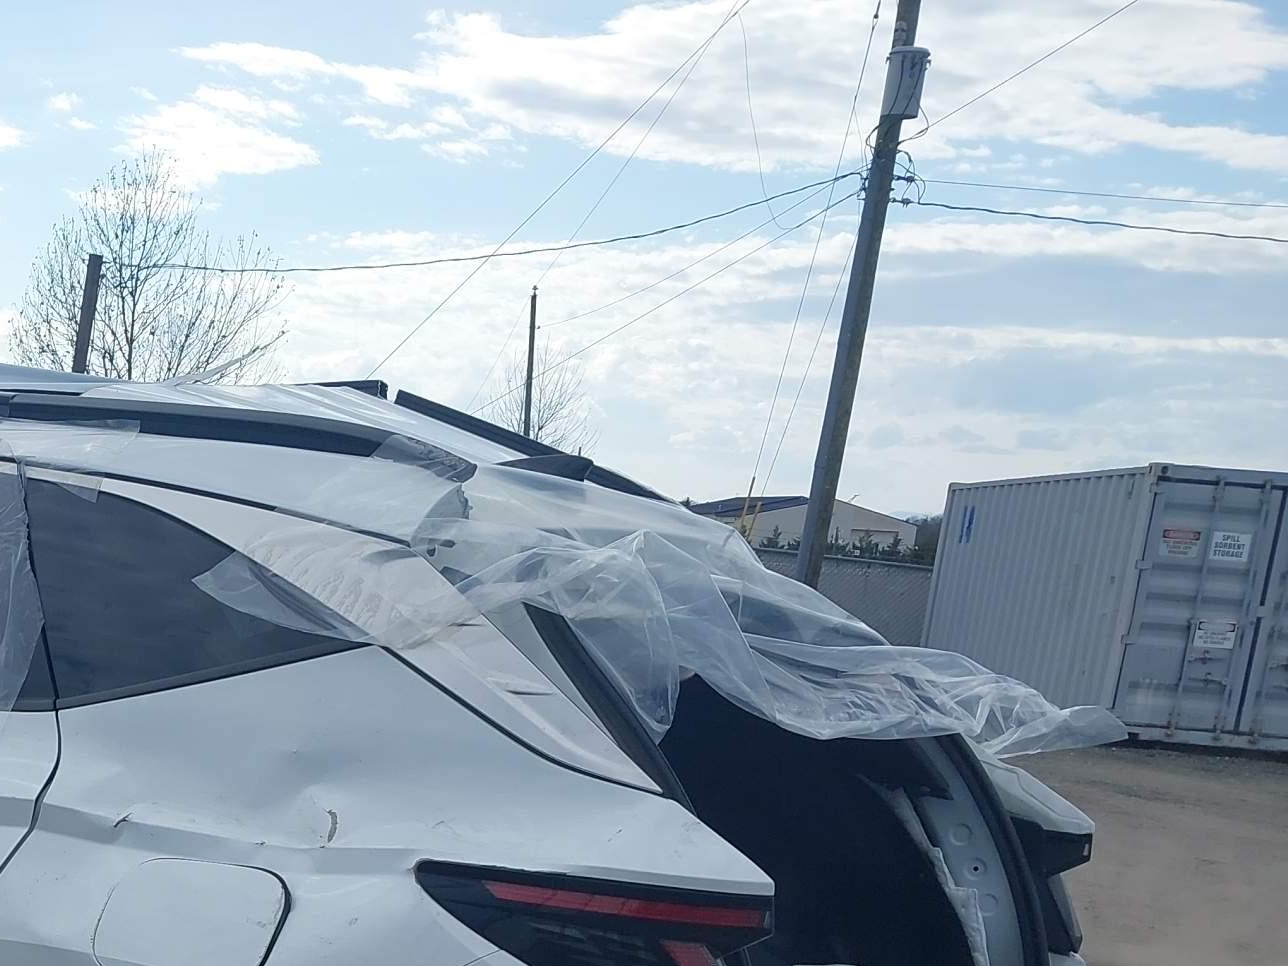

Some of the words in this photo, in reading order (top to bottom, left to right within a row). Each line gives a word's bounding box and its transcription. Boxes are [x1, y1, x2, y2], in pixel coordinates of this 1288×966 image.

[1222, 534, 1241, 542] SPILL
[1214, 541, 1245, 550] SORBENT
[1213, 549, 1244, 558] STORAGE
